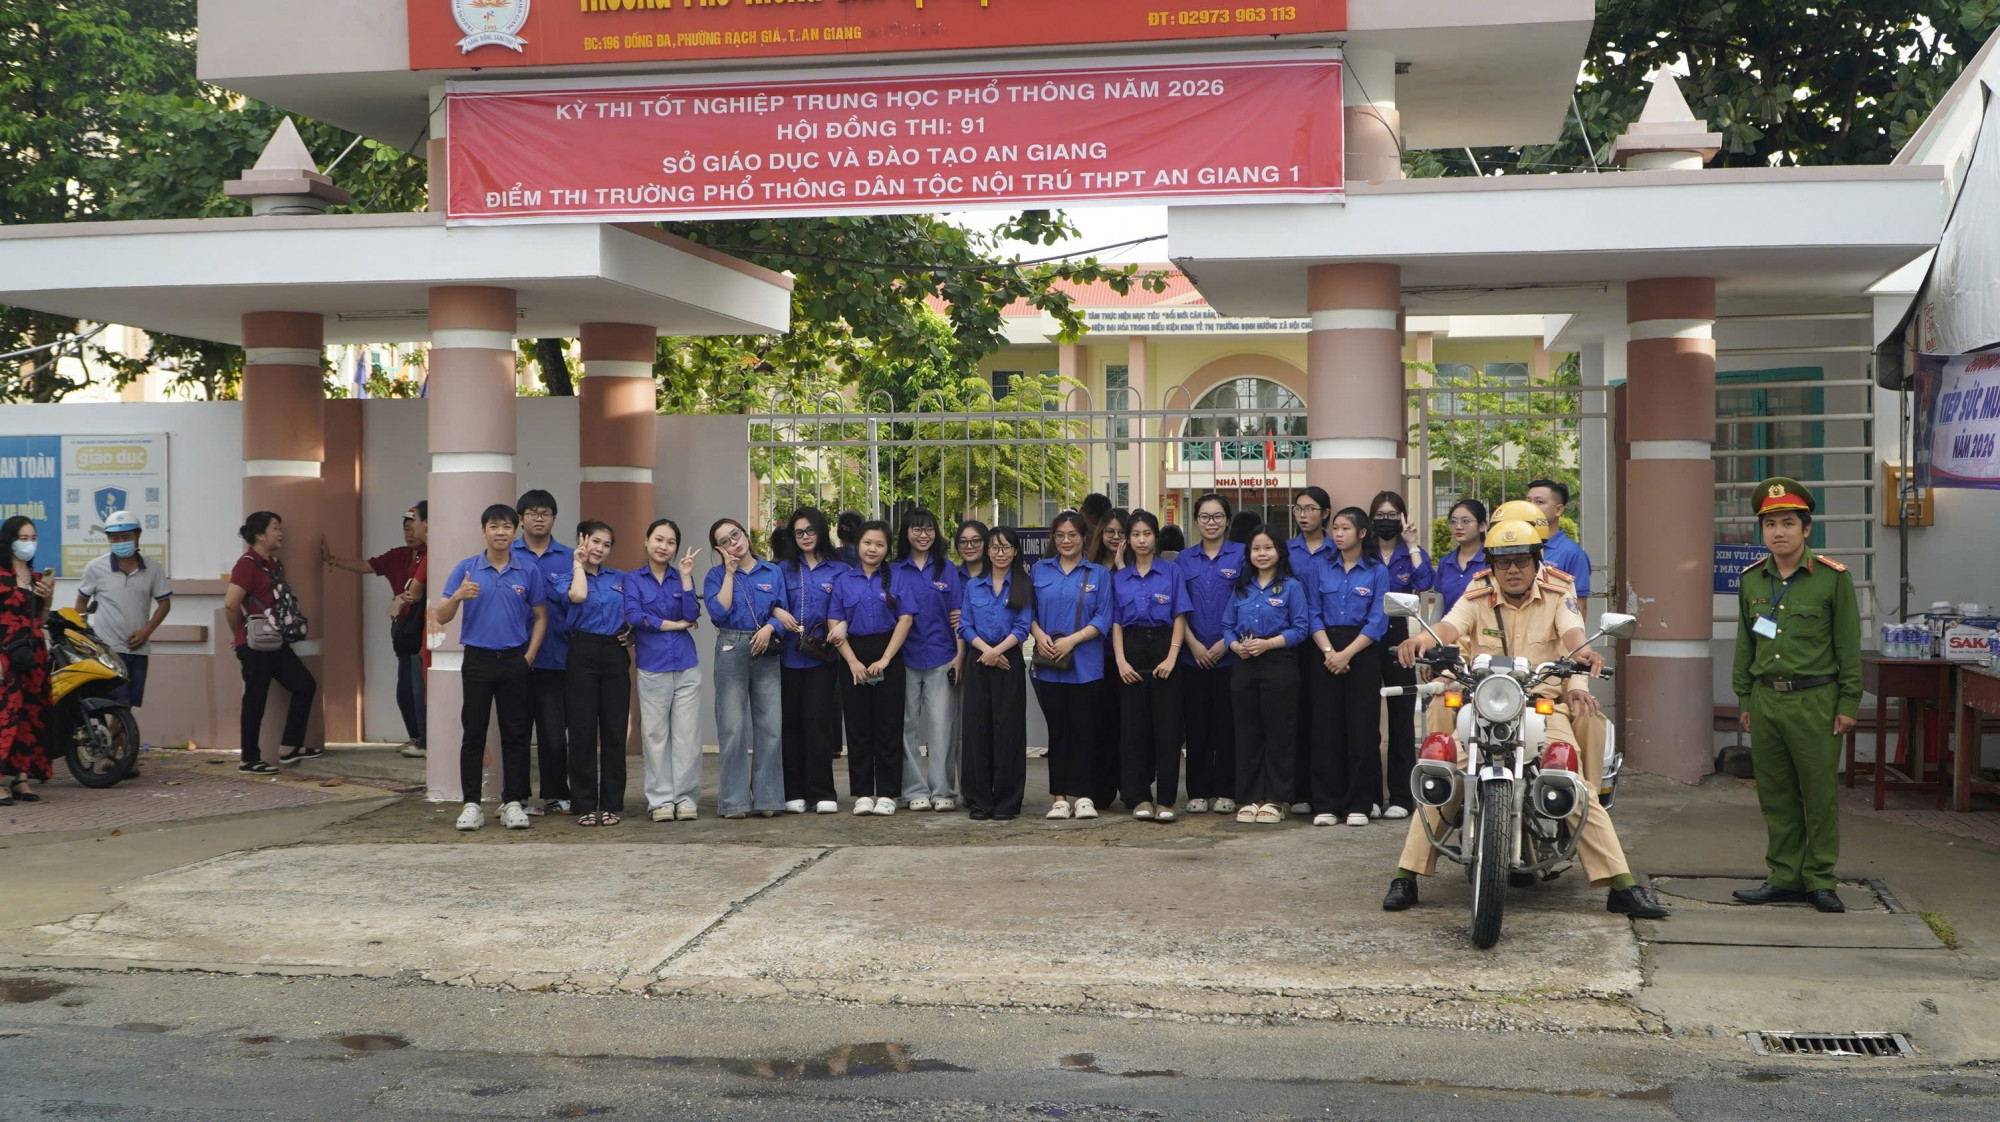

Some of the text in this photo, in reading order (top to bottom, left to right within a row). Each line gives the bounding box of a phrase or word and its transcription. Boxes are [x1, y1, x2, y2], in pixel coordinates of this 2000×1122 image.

[1178, 9, 1230, 25] 02973
[1235, 7, 1267, 23] 963
[1270, 5, 1296, 22] 113
[724, 30, 757, 48] RẠCH
[823, 25, 862, 40] GIANG
[556, 77, 1225, 120] KỲ THI TỐT NGHIỆP TRUNG HỌC PHỔ THÔNG NĂM 2026
[777, 114, 985, 143] HỘI ĐỒNG THI: 91
[662, 141, 1107, 175] SỞ GIÁO DỤC VÀ ĐÀO TẠO AN GIANG
[485, 165, 1300, 208] ĐIỂM THI TRƯỜNG PHỔ THÔNG DÂN TỘC NỘI TRÚ THPT AN GIANG 1
[1958, 379, 1984, 423] SỨC
[1952, 429, 1996, 459] NĂM 2026
[20, 452, 56, 479] TOÀN
[1216, 477, 1279, 489] NHÀ HIỆU BỘ
[1022, 534, 1040, 555] LÒNG
[1716, 550, 1732, 560] XIN
[1733, 551, 1749, 560] VUI
